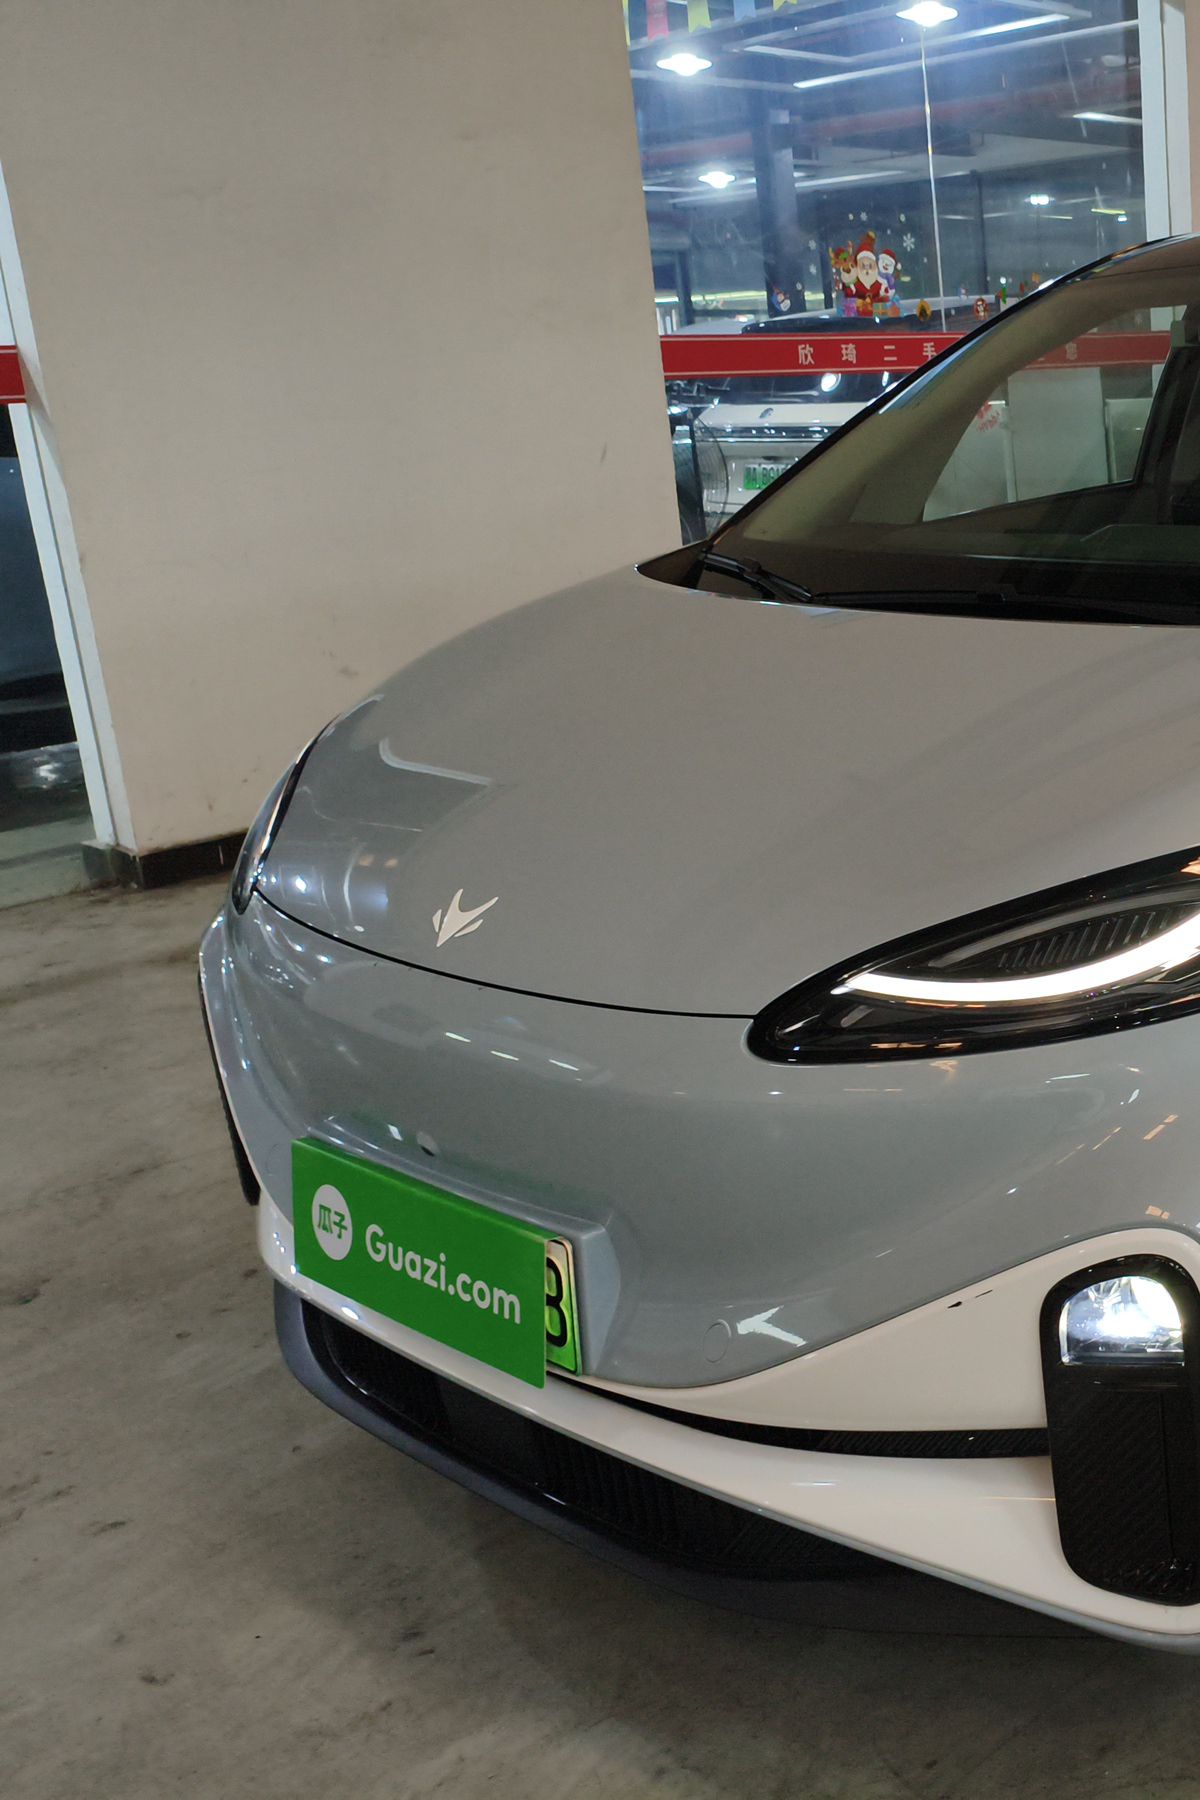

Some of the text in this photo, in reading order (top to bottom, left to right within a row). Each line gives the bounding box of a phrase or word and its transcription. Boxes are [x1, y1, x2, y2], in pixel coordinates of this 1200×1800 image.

[798, 342, 937, 365] 欣琦二手
[317, 1203, 348, 1239] 瓜子
[365, 1223, 521, 1325] Guazi.com
